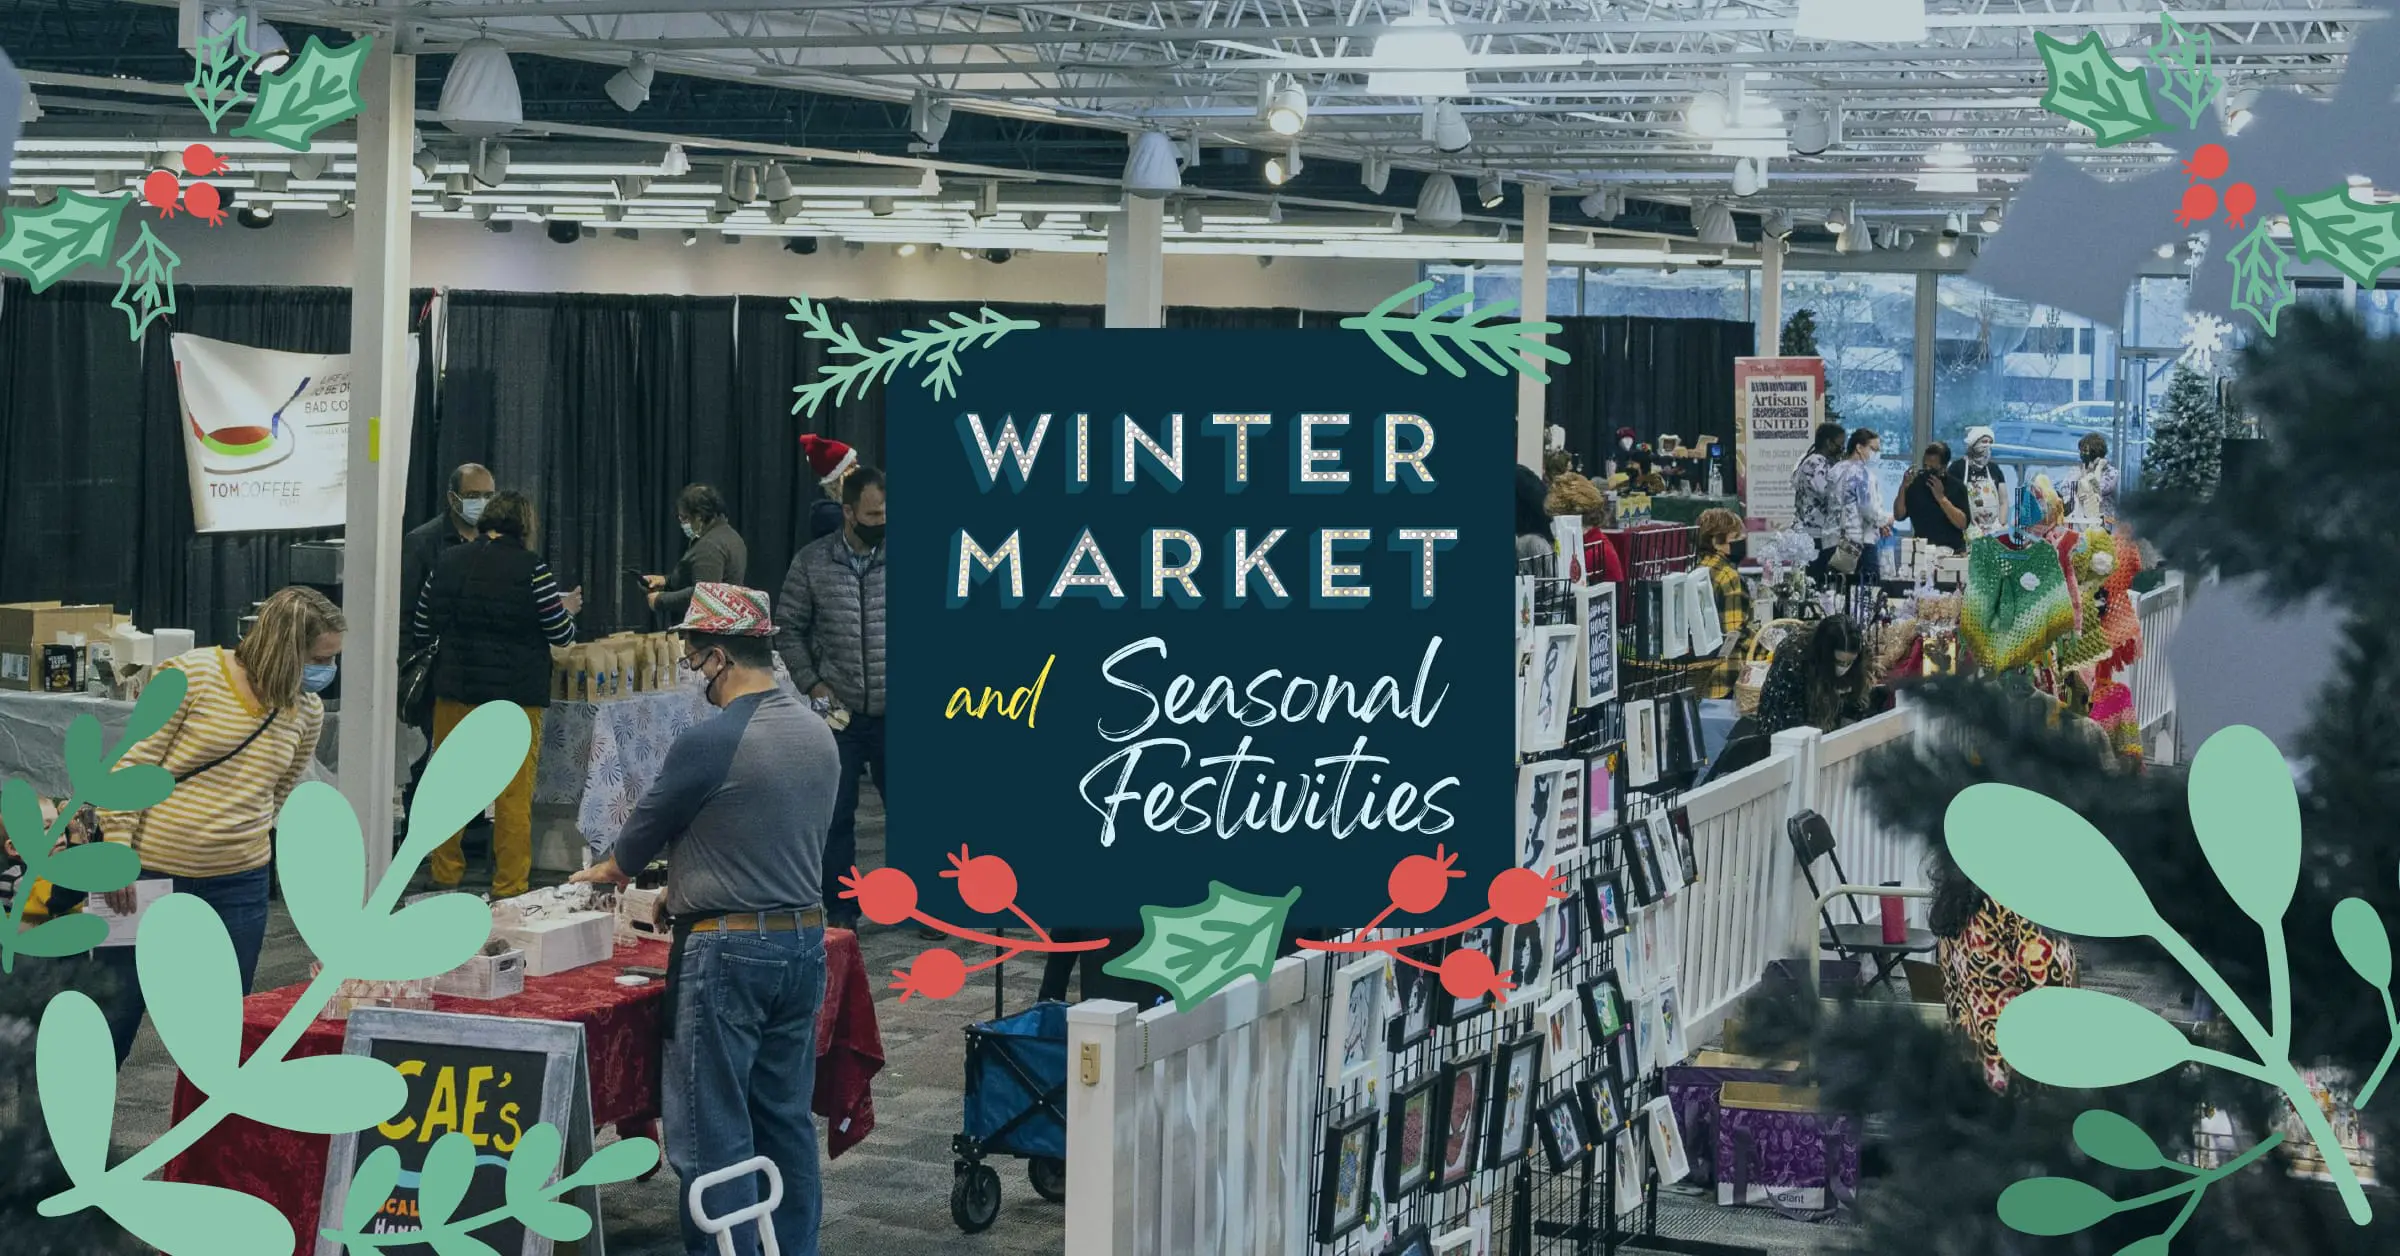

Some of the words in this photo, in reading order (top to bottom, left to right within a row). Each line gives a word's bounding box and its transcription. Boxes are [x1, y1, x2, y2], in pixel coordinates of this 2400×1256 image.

[1752, 393, 1807, 406] Artisans
[304, 402, 327, 413] BAD
[331, 400, 350, 412] CO
[1752, 419, 1809, 429] UNITED
[209, 480, 302, 498] TOMCOFFEE
[1777, 1193, 1805, 1204] Giant
